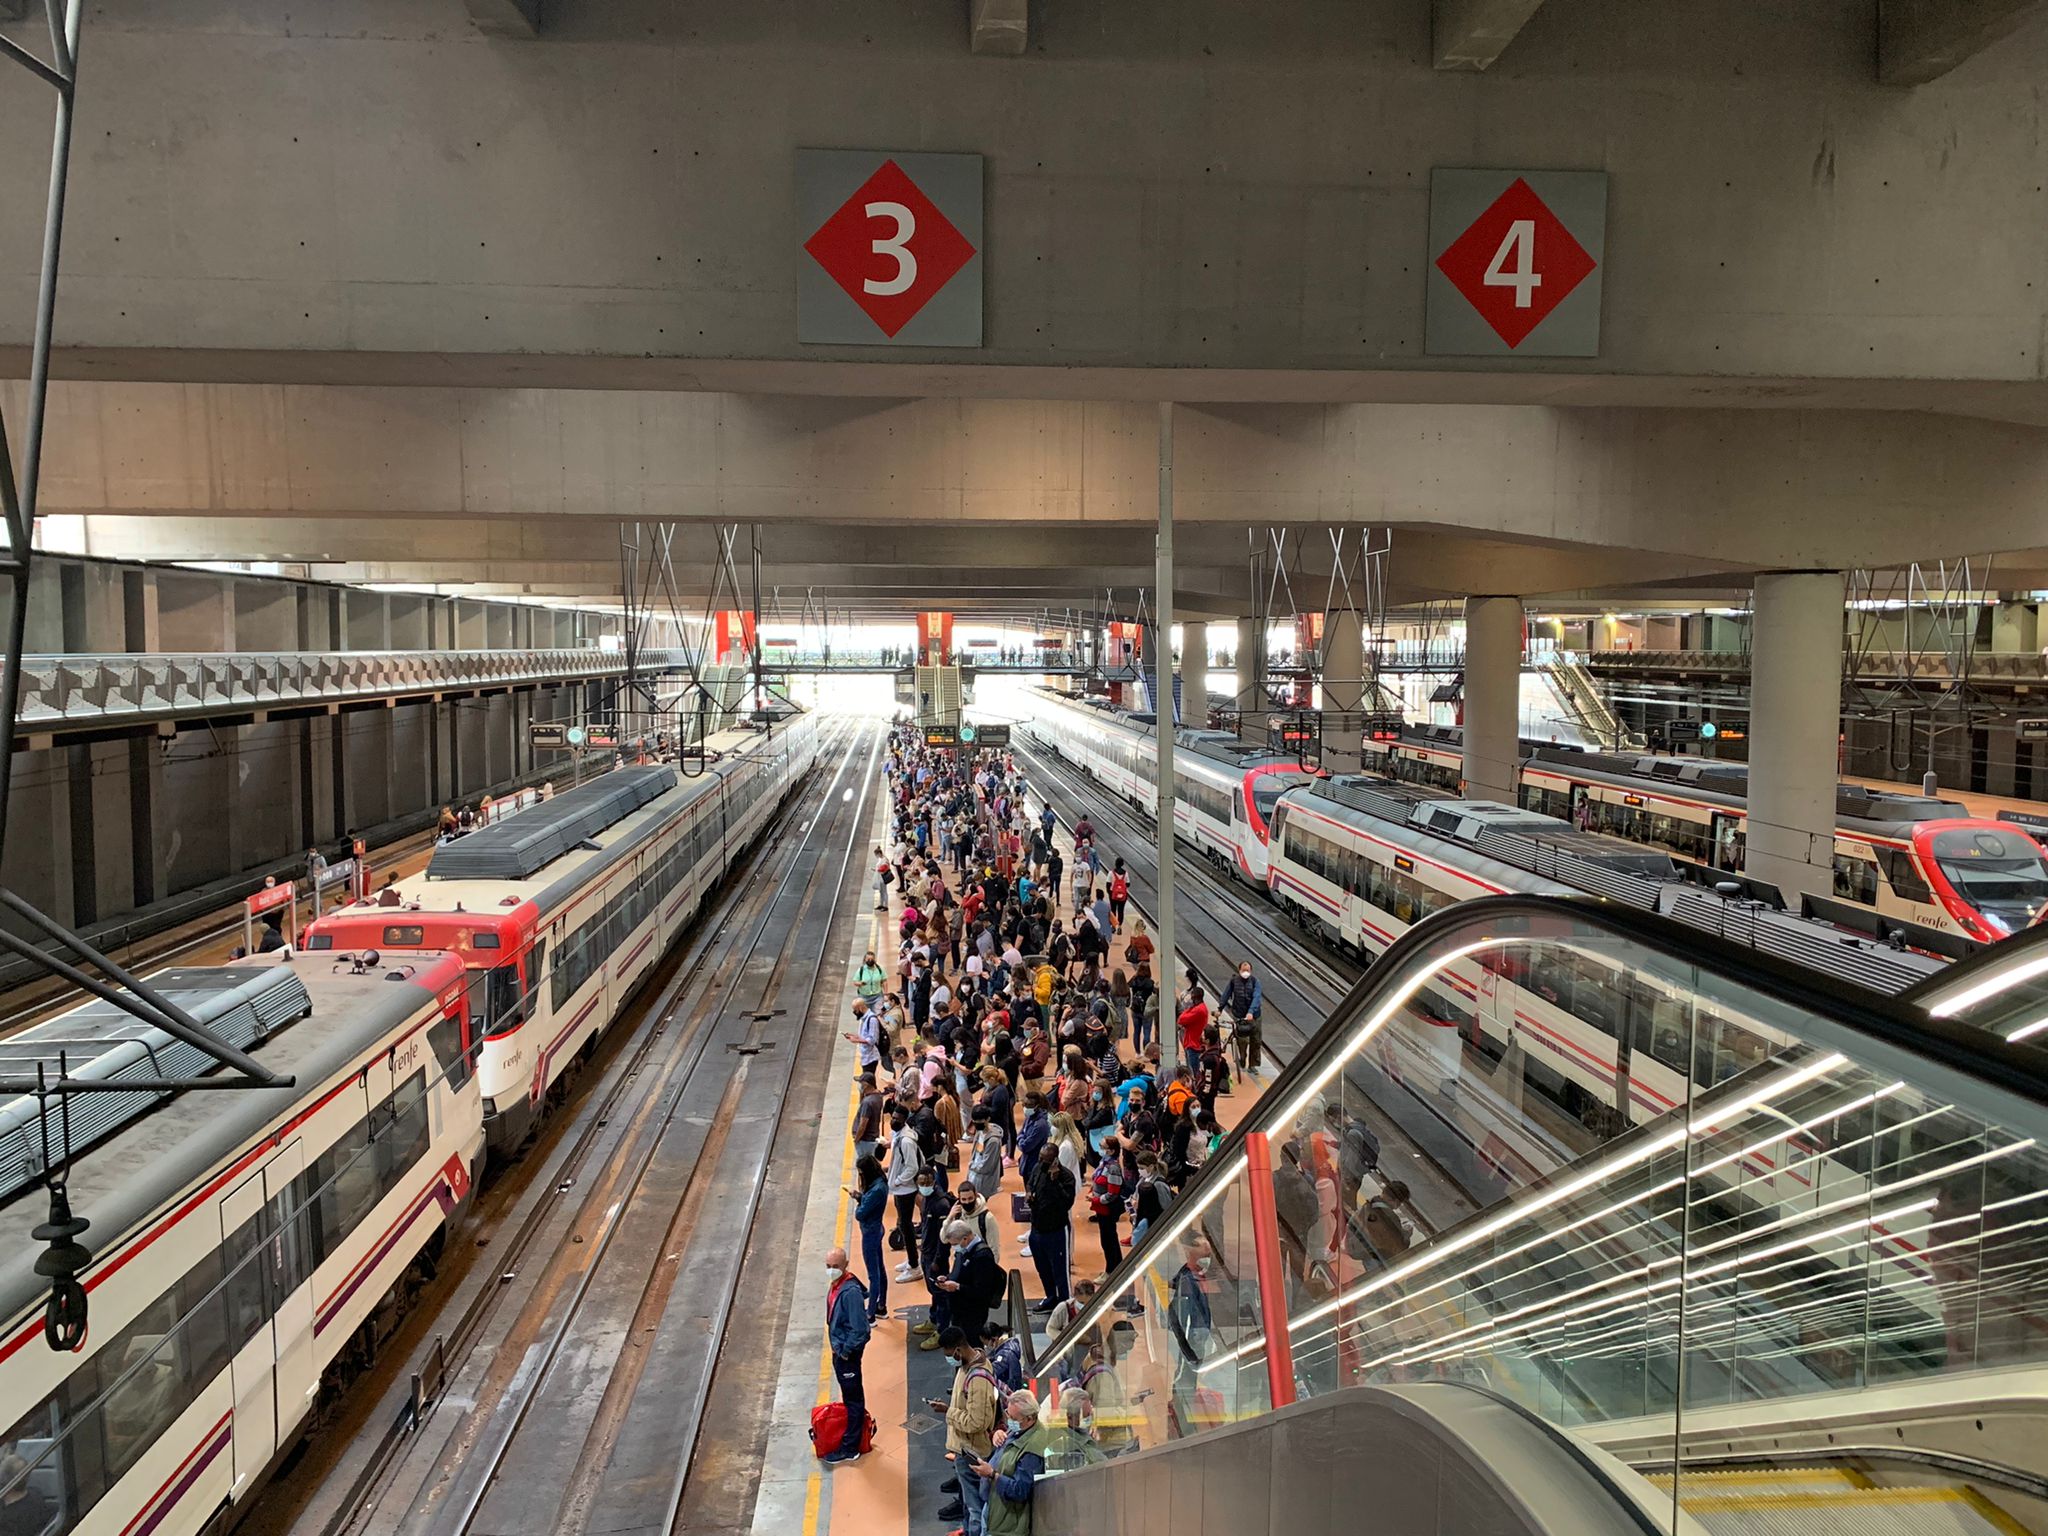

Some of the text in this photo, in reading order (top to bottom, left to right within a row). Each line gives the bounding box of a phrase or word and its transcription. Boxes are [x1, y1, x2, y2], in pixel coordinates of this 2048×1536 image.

[863, 201, 917, 296] 3
[1483, 219, 1542, 308] 4
[1916, 914, 1949, 929] renfe
[393, 1041, 419, 1075] renfe
[502, 1048, 523, 1070] renfe
